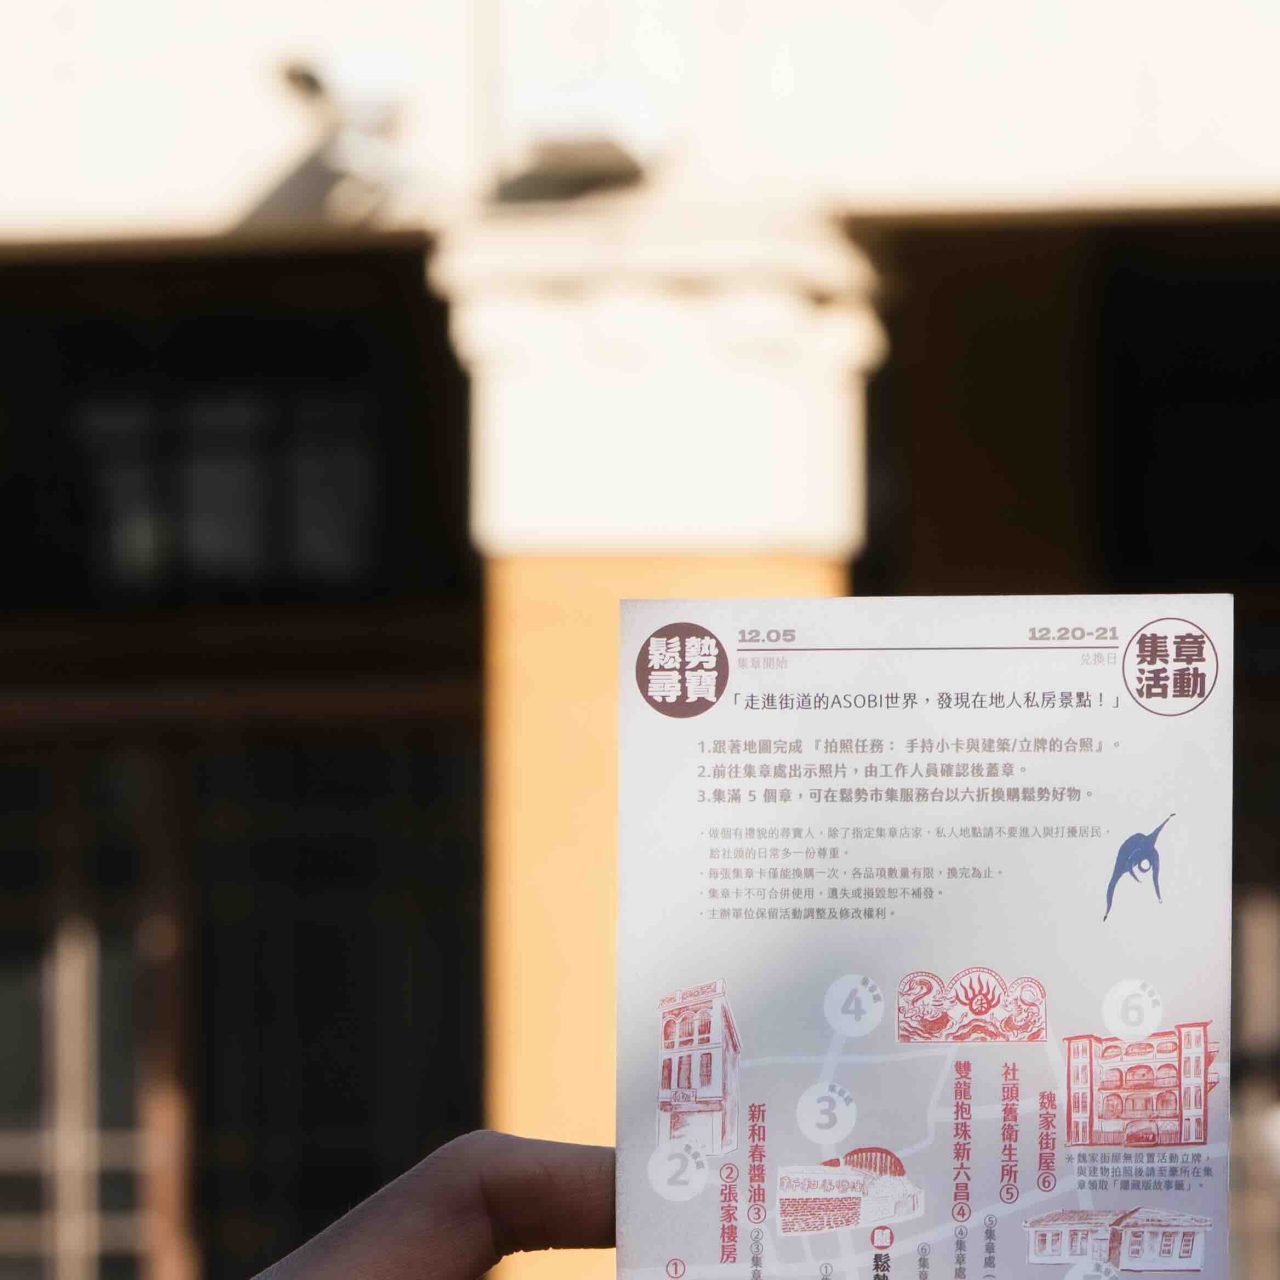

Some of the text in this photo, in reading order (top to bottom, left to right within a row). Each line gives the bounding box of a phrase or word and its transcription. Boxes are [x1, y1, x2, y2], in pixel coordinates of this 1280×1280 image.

[737, 629, 797, 643] 12.05
[1028, 626, 1119, 641] 12.20-21
[1135, 633, 1207, 666] 集章
[647, 636, 719, 670] 鬆勢
[647, 670, 718, 704] 尋寶
[1135, 666, 1207, 699] 活動
[840, 987, 867, 1022] 4
[815, 1095, 838, 1130] 3
[666, 1153, 690, 1186] 2
